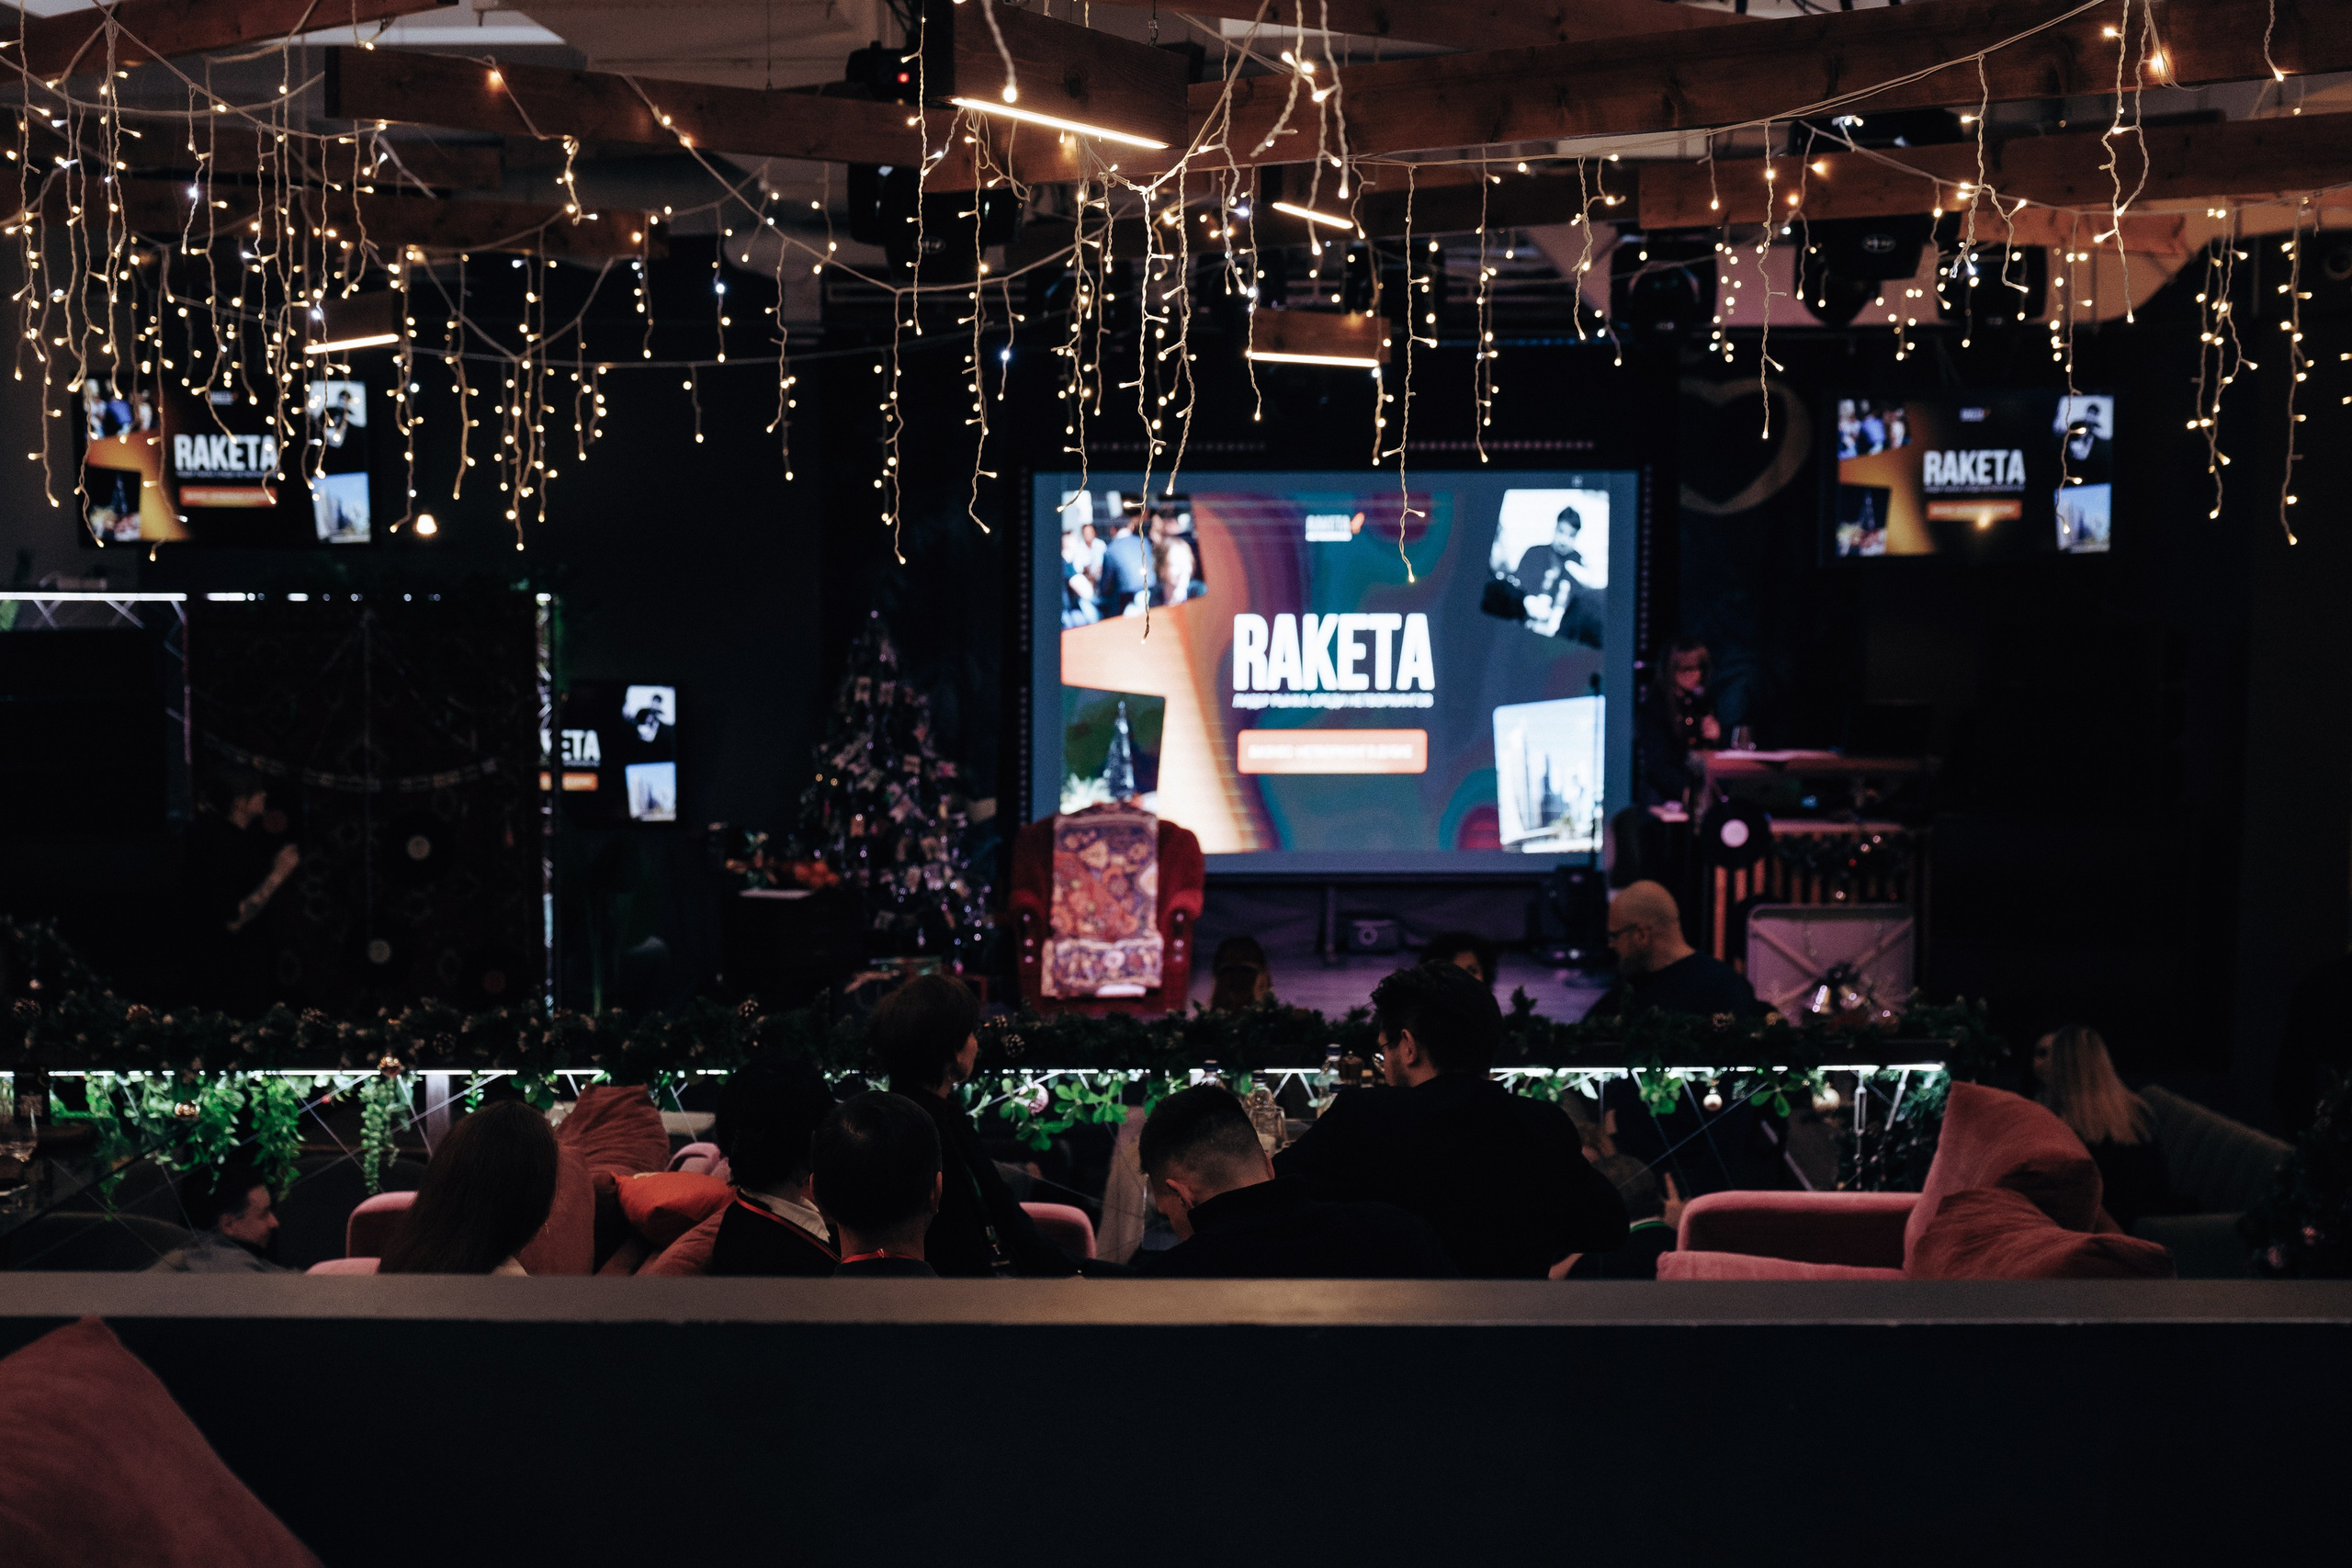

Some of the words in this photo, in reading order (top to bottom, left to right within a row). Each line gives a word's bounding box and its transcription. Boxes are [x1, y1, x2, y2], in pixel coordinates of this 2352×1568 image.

[174, 434, 278, 471] RAKETA
[1923, 449, 2026, 486] RAKETA
[1233, 613, 1435, 691] RAKETA
